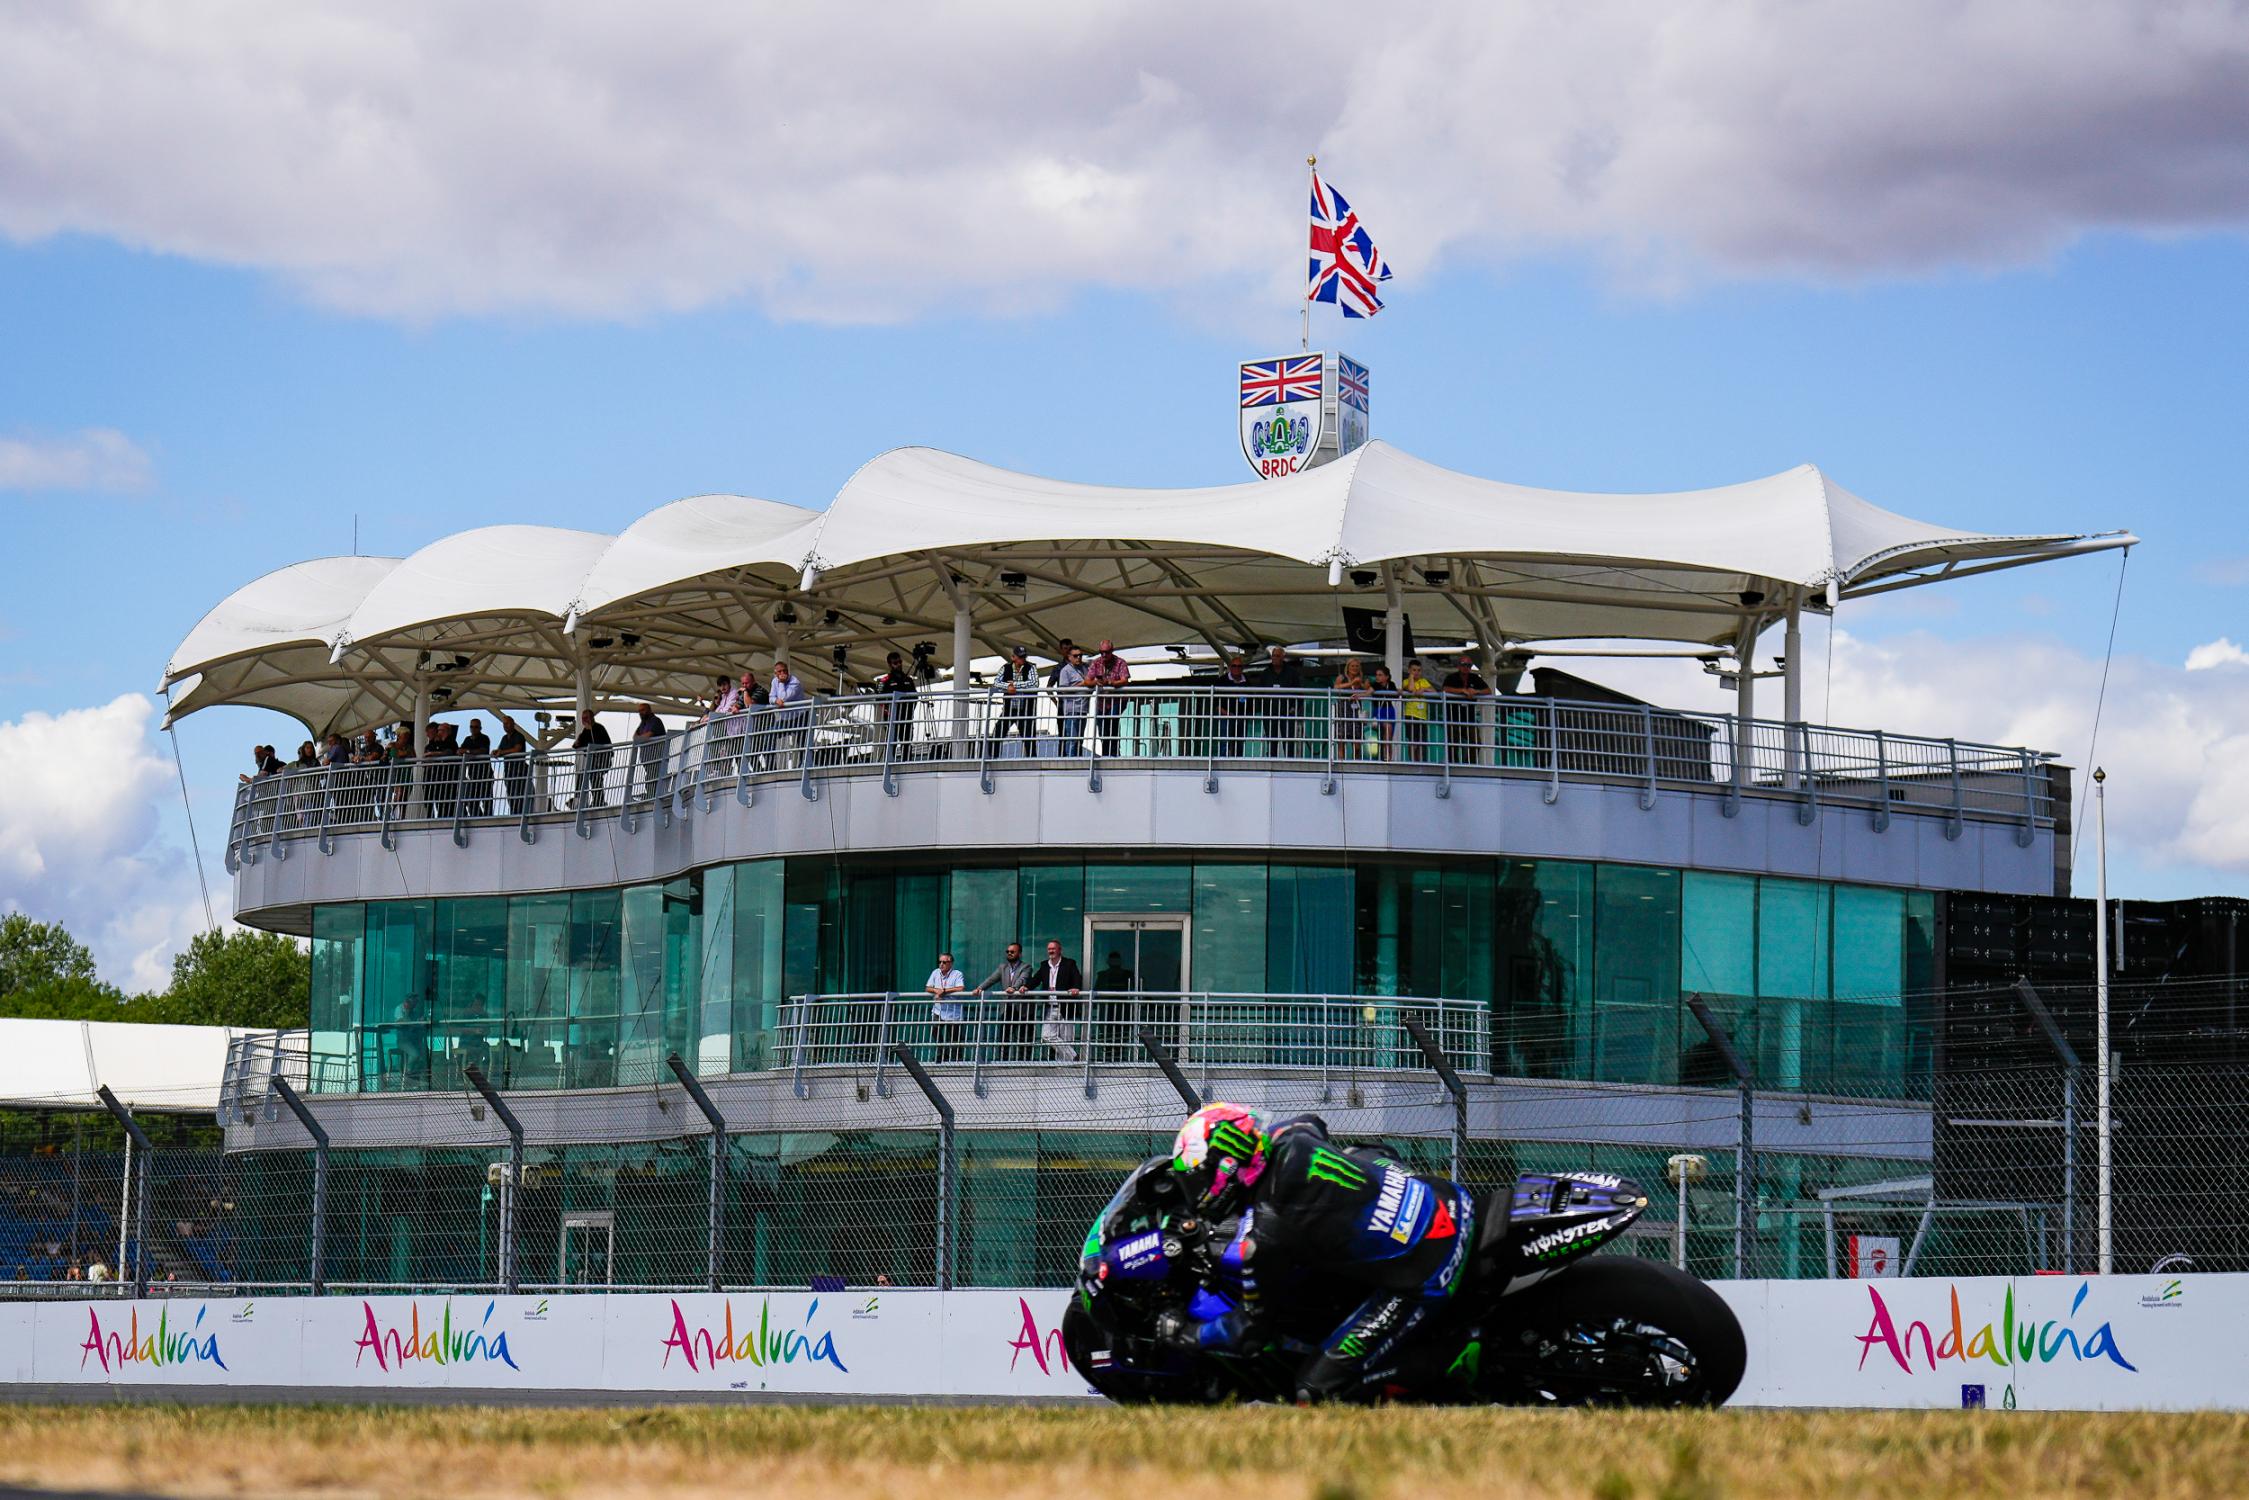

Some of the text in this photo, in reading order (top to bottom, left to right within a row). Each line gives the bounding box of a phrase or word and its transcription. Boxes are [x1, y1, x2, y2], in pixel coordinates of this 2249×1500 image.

[1262, 456, 1297, 478] BRDC
[1367, 1165, 1407, 1233] YAMAHA
[1118, 1232, 1160, 1262] YAMAHA
[1521, 1217, 1612, 1257] MONSTER
[81, 1303, 229, 1374] Andalucía
[354, 1299, 520, 1372] Andalucía
[661, 1297, 848, 1373] Andalucía
[1854, 1281, 2139, 1375] Andalucía
